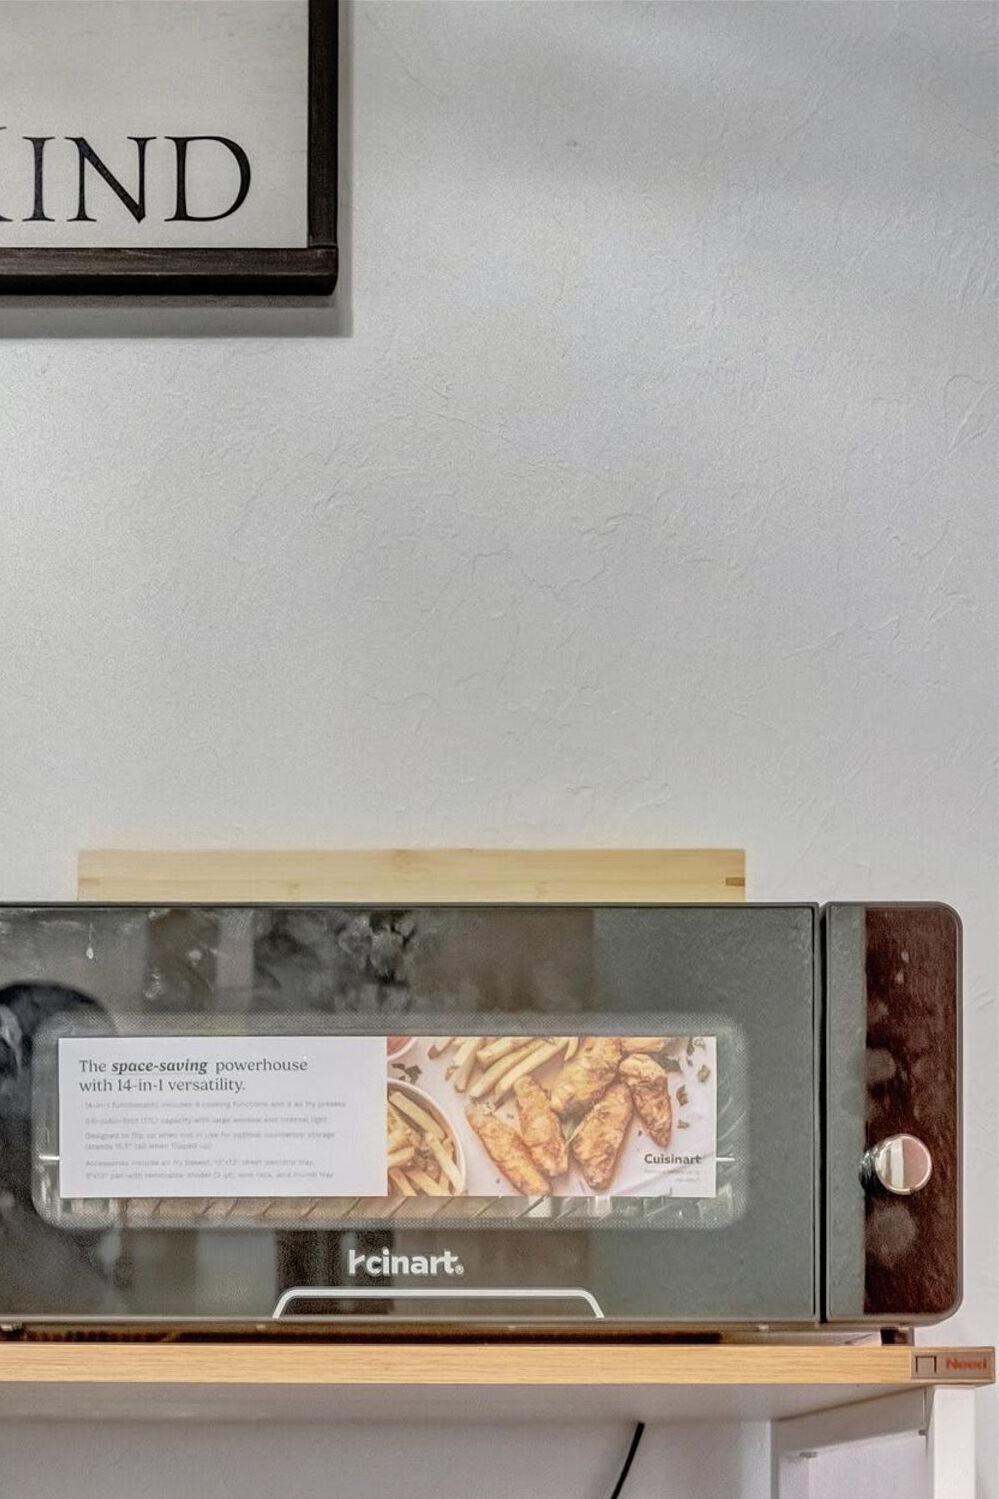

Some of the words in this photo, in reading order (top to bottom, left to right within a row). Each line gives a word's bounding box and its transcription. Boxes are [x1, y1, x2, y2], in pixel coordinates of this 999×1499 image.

[79, 1059, 107, 1073] The
[111, 1058, 208, 1075] space-saving
[215, 1058, 309, 1072] powerhouse
[79, 1078, 113, 1092] with
[117, 1078, 163, 1092] 14-in-1
[168, 1077, 246, 1093] versatility.
[644, 1153, 702, 1164] Cuisinart
